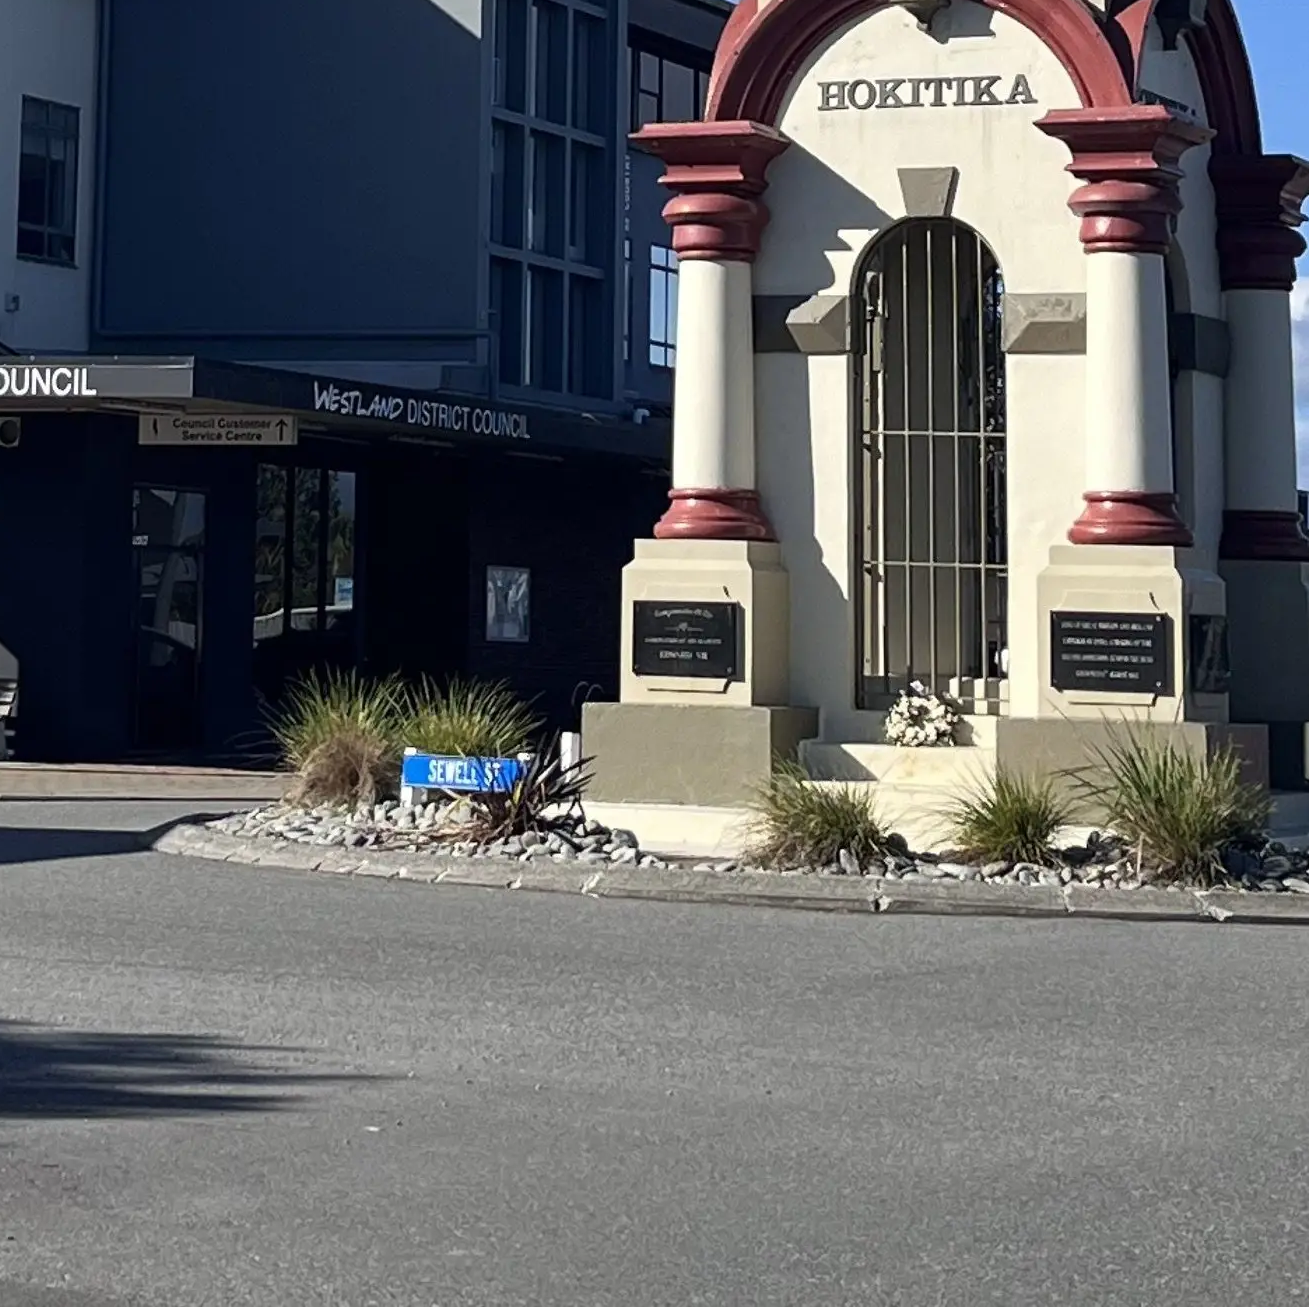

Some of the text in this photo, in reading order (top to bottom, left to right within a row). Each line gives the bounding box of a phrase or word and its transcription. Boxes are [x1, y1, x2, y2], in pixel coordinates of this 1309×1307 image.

[817, 74, 1038, 111] HOKITIKA
[172, 417, 271, 429] Council Customer
[314, 381, 531, 439] WESTLAND DISTRICT COUNCIL
[182, 430, 262, 441] Service Centre
[427, 759, 479, 785] SEWELL
